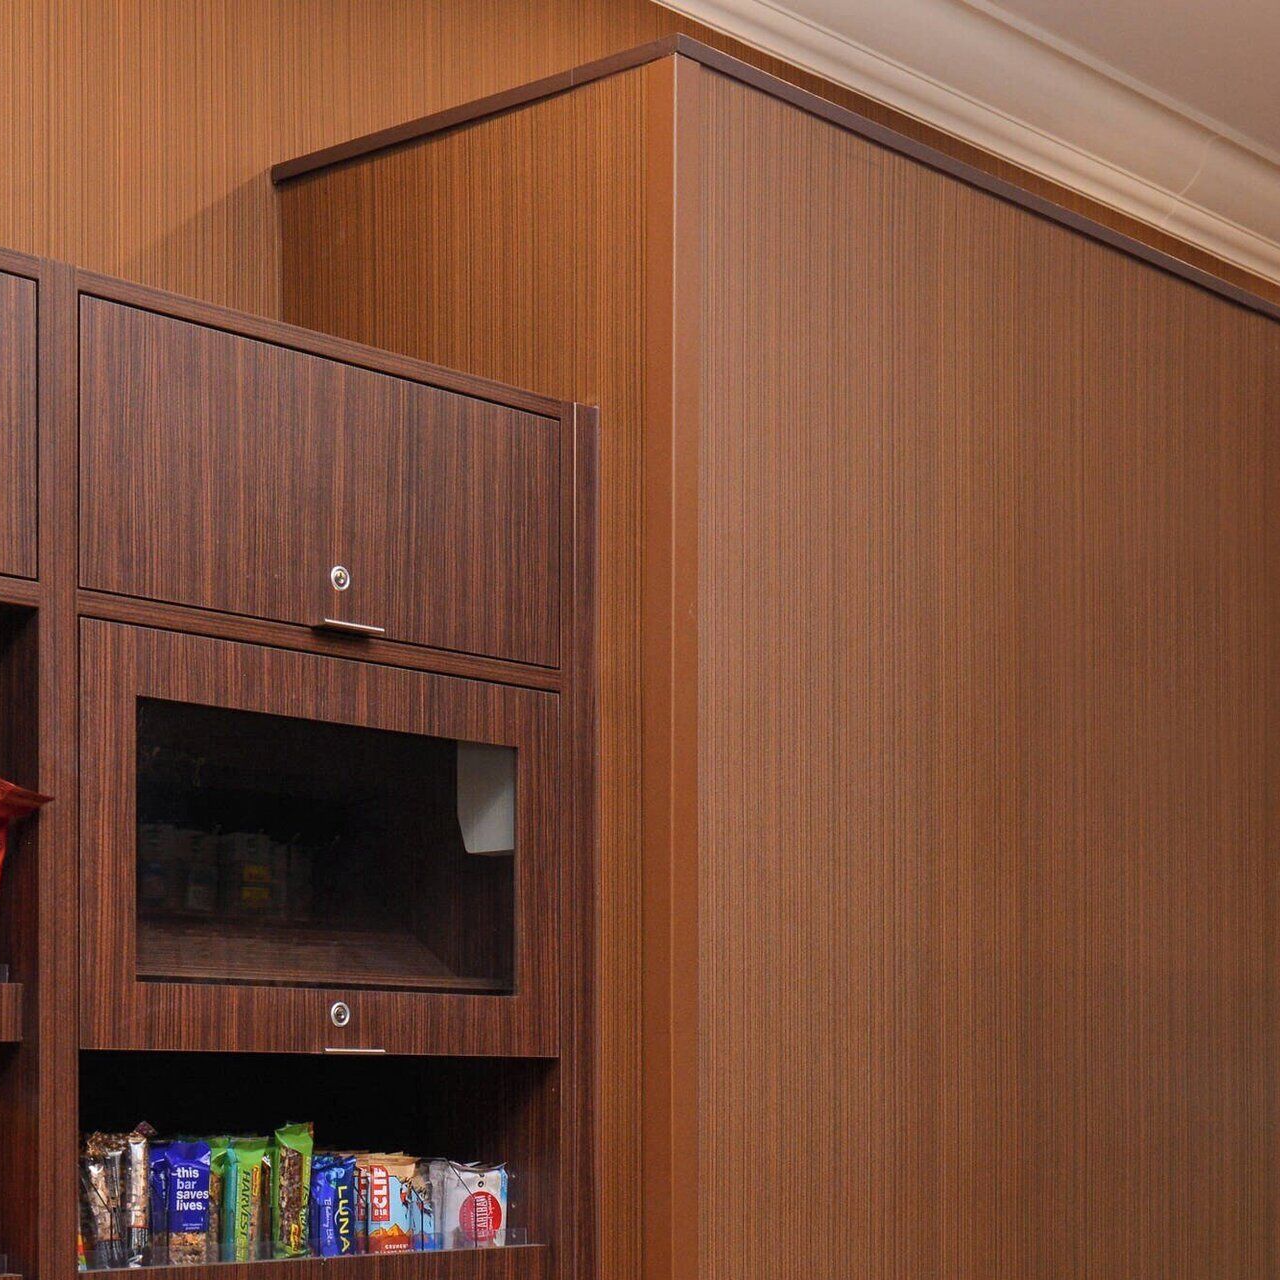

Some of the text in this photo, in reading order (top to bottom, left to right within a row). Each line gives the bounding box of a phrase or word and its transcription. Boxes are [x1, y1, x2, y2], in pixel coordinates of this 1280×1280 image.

[176, 1167, 200, 1179] this
[176, 1179, 197, 1190] bar
[373, 1167, 390, 1208] CLIF
[176, 1190, 209, 1200] saves
[176, 1200, 206, 1212] lives.
[238, 1169, 251, 1238] HARVEST
[338, 1185, 351, 1252] LUNA
